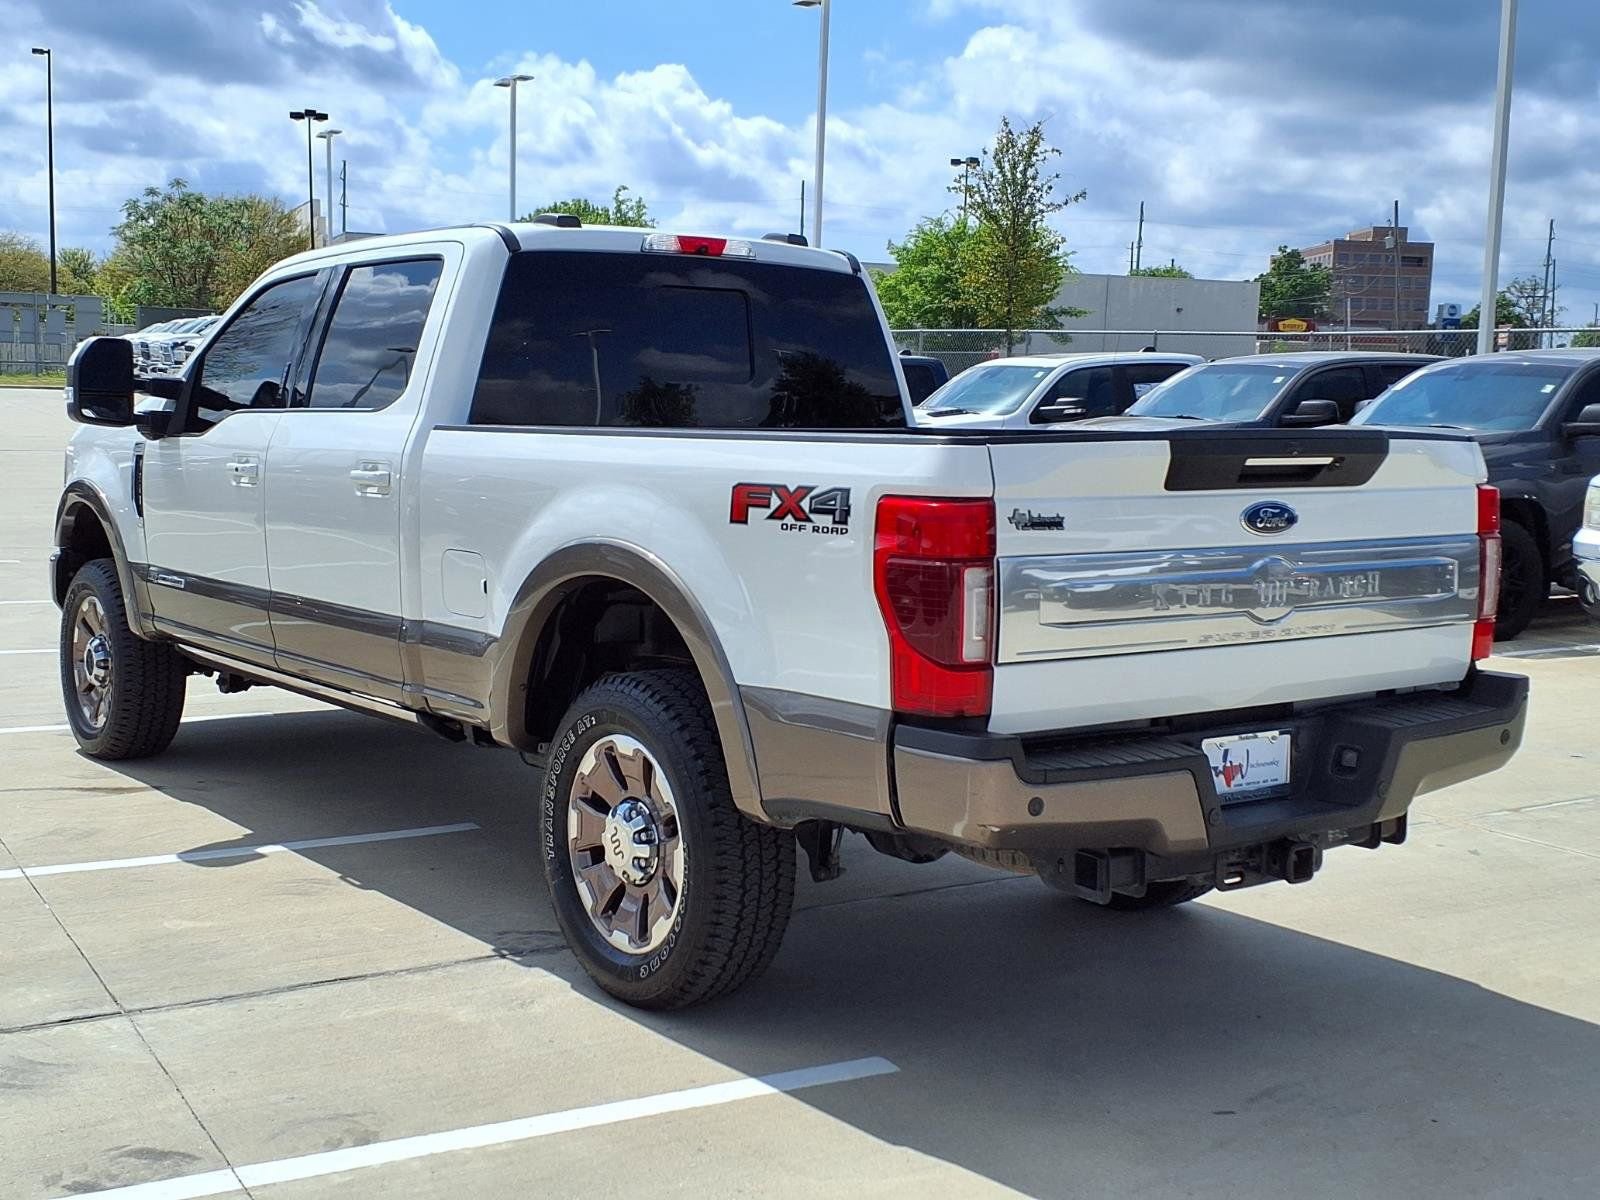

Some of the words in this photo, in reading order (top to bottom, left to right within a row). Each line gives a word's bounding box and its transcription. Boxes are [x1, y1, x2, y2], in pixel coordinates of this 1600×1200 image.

[729, 482, 851, 526] FX4
[1256, 508, 1288, 528] Ford
[780, 523, 807, 532] OFF
[812, 525, 848, 535] ROAD
[1309, 571, 1381, 599] RANCH
[544, 729, 576, 861] TRANSFORCE
